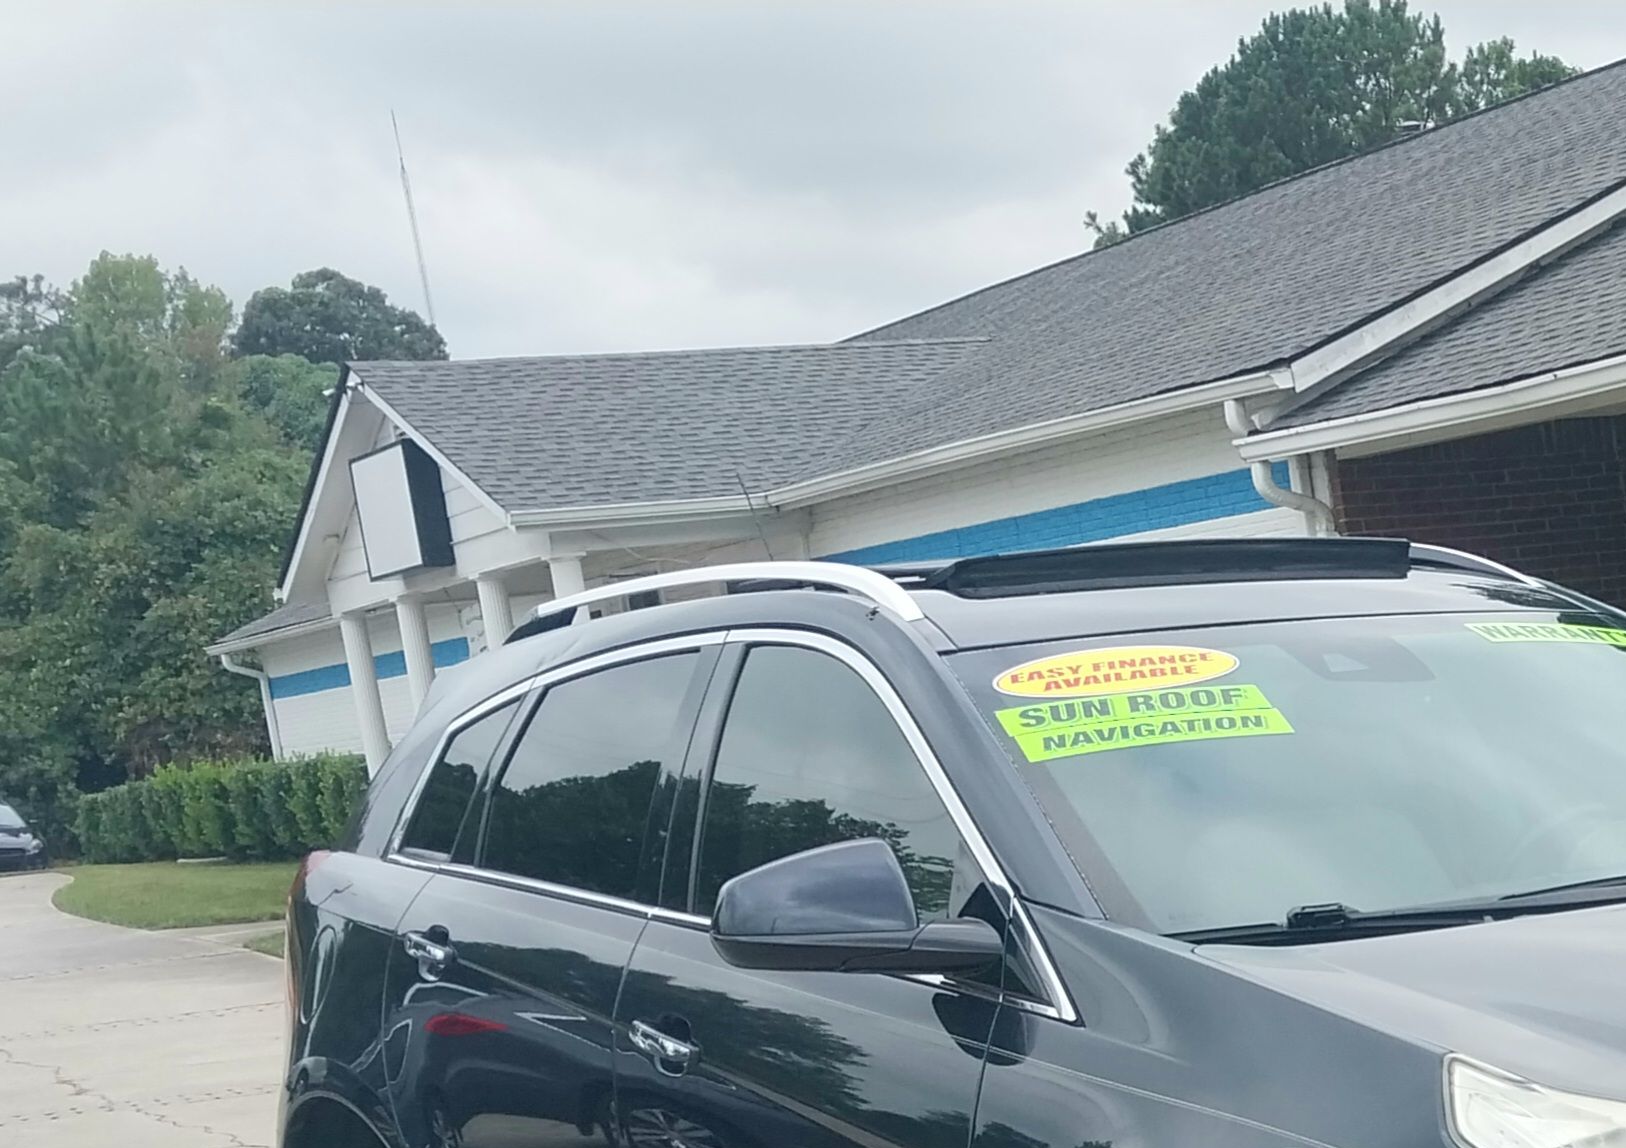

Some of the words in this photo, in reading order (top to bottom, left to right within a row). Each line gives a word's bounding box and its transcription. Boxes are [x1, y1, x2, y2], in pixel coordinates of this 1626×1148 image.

[1010, 665, 1084, 685] EASY
[1091, 653, 1214, 673] FINANCE
[1043, 665, 1199, 691] AVAILABLE
[1019, 698, 1112, 728] SUN
[1129, 688, 1245, 713] ROOF
[1043, 715, 1265, 751] NAVIGATION
